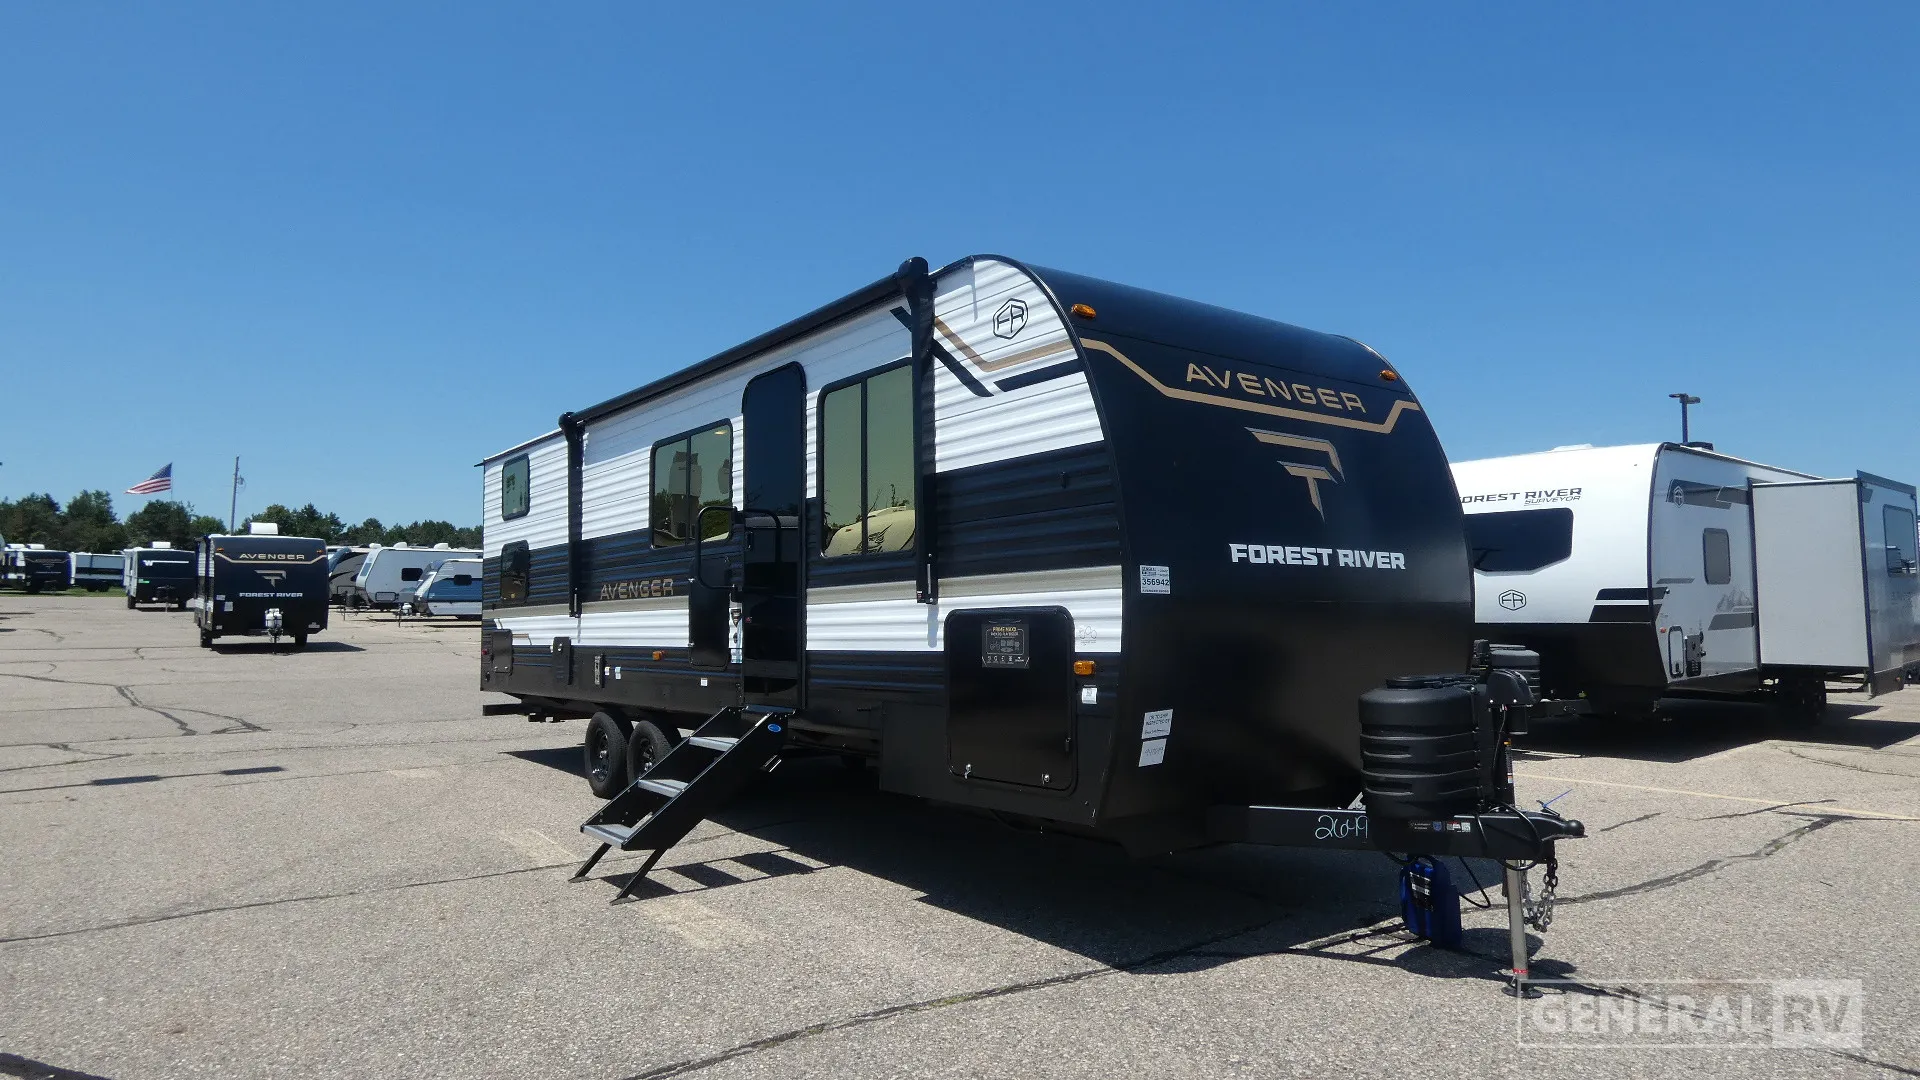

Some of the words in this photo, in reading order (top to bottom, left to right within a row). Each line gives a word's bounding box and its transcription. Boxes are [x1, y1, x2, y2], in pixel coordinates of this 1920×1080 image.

[1186, 363, 1367, 414] AVENGER
[1459, 492, 1520, 504] OREST
[1525, 488, 1582, 499] RIVER
[1524, 495, 1581, 505] SURVEYOR
[1229, 543, 1333, 567] FOREST
[1336, 548, 1406, 570] RIVER
[600, 578, 674, 600] AVENGER
